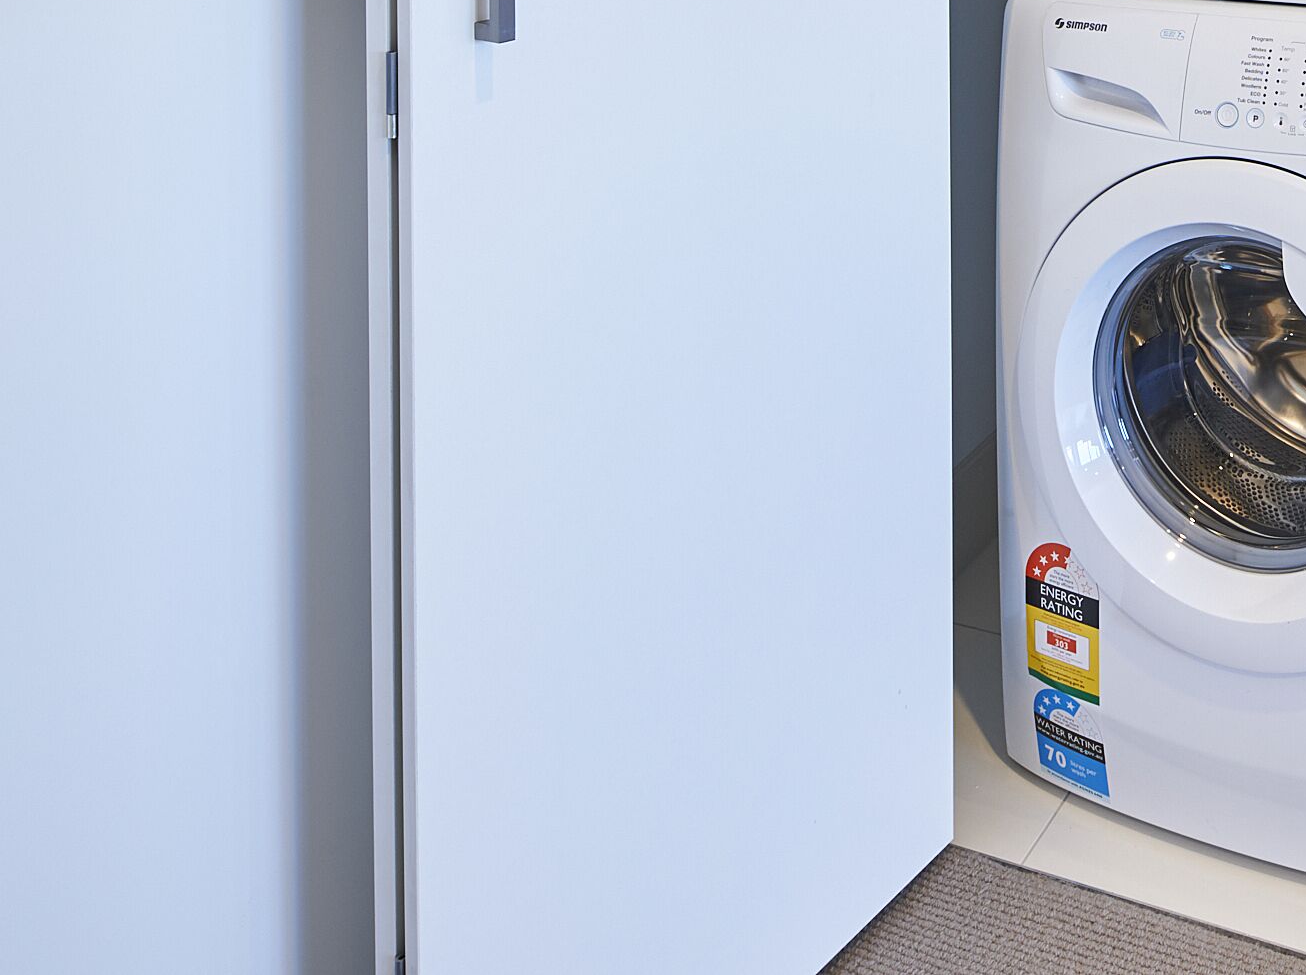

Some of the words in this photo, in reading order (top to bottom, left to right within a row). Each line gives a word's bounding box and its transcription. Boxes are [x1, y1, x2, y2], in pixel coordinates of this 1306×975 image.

[1066, 20, 1108, 32] SIMPSON
[1041, 584, 1083, 607] ENERGY
[1041, 597, 1082, 621] RATING
[1036, 715, 1066, 738] WATER
[1068, 733, 1102, 754] RATING
[1045, 744, 1066, 768] 70
